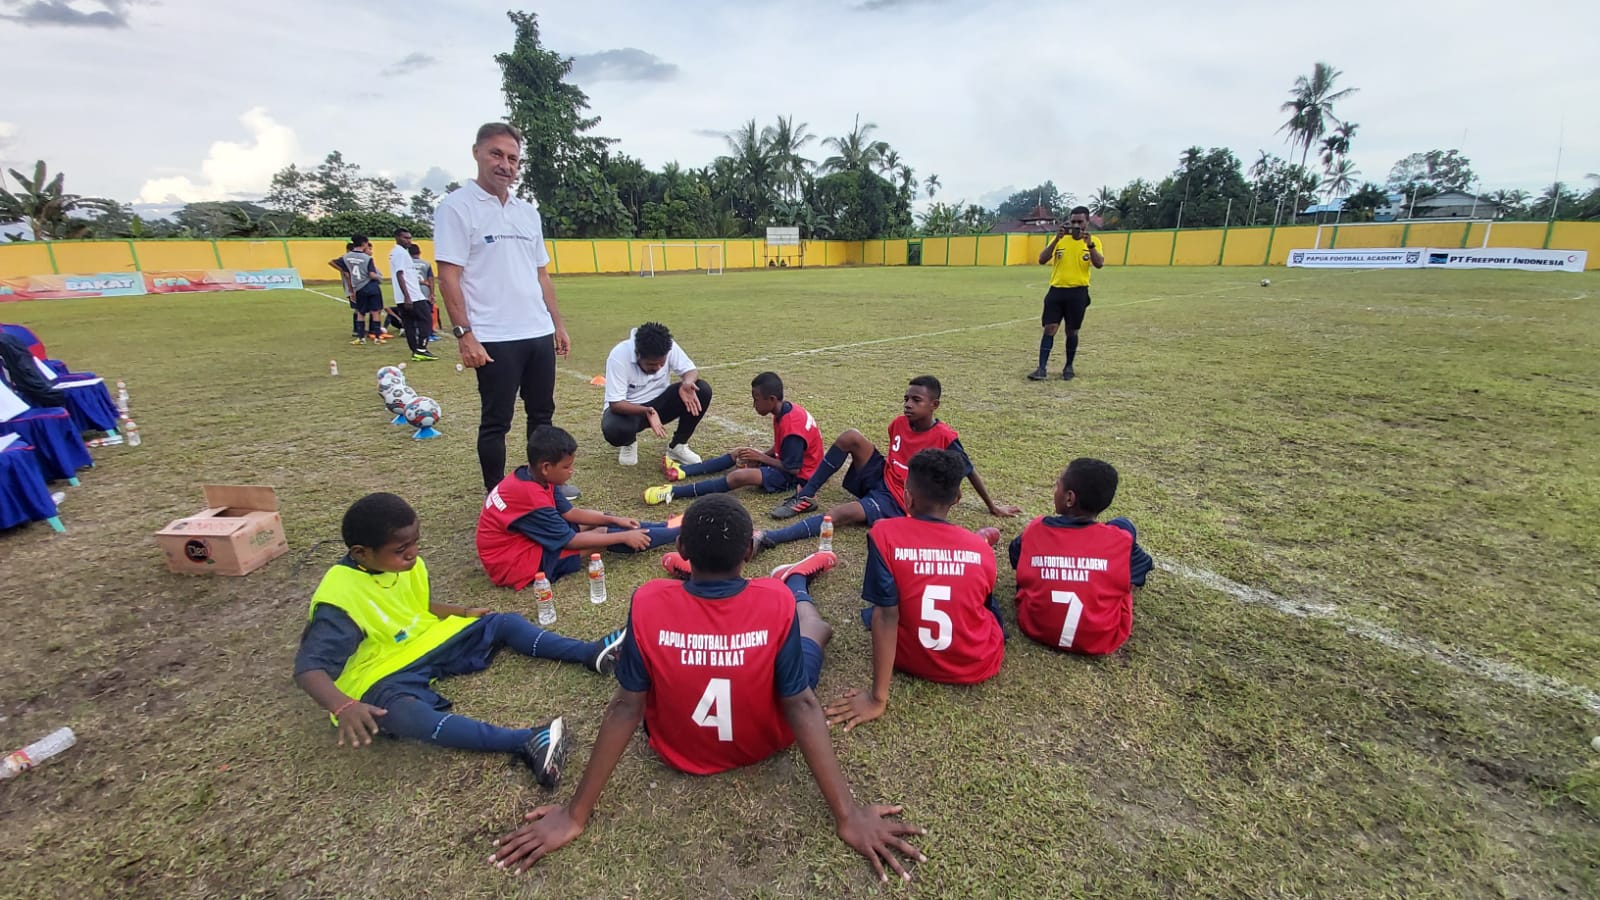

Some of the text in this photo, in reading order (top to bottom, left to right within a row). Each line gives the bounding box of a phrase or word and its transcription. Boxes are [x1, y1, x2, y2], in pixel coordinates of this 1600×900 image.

[233, 271, 293, 283] BAKAT
[352, 265, 361, 280] 4
[64, 279, 134, 290] BAKAT
[153, 277, 189, 287] PFA
[892, 435, 901, 452] 3
[894, 547, 982, 566] PAPUA FOOTBALL ACADEMY
[1044, 556, 1076, 569] FOOTBALL
[1077, 557, 1108, 571] ACADEMY
[914, 562, 966, 576] CARI BAKAT
[1041, 568, 1089, 582] CARI BAKAT
[918, 584, 953, 651] 5
[1051, 590, 1084, 648] 7
[658, 630, 769, 651] PAPUA FOOTBALL ACADEMY
[681, 650, 745, 667] CARI BAKAT
[691, 677, 733, 742] 4
